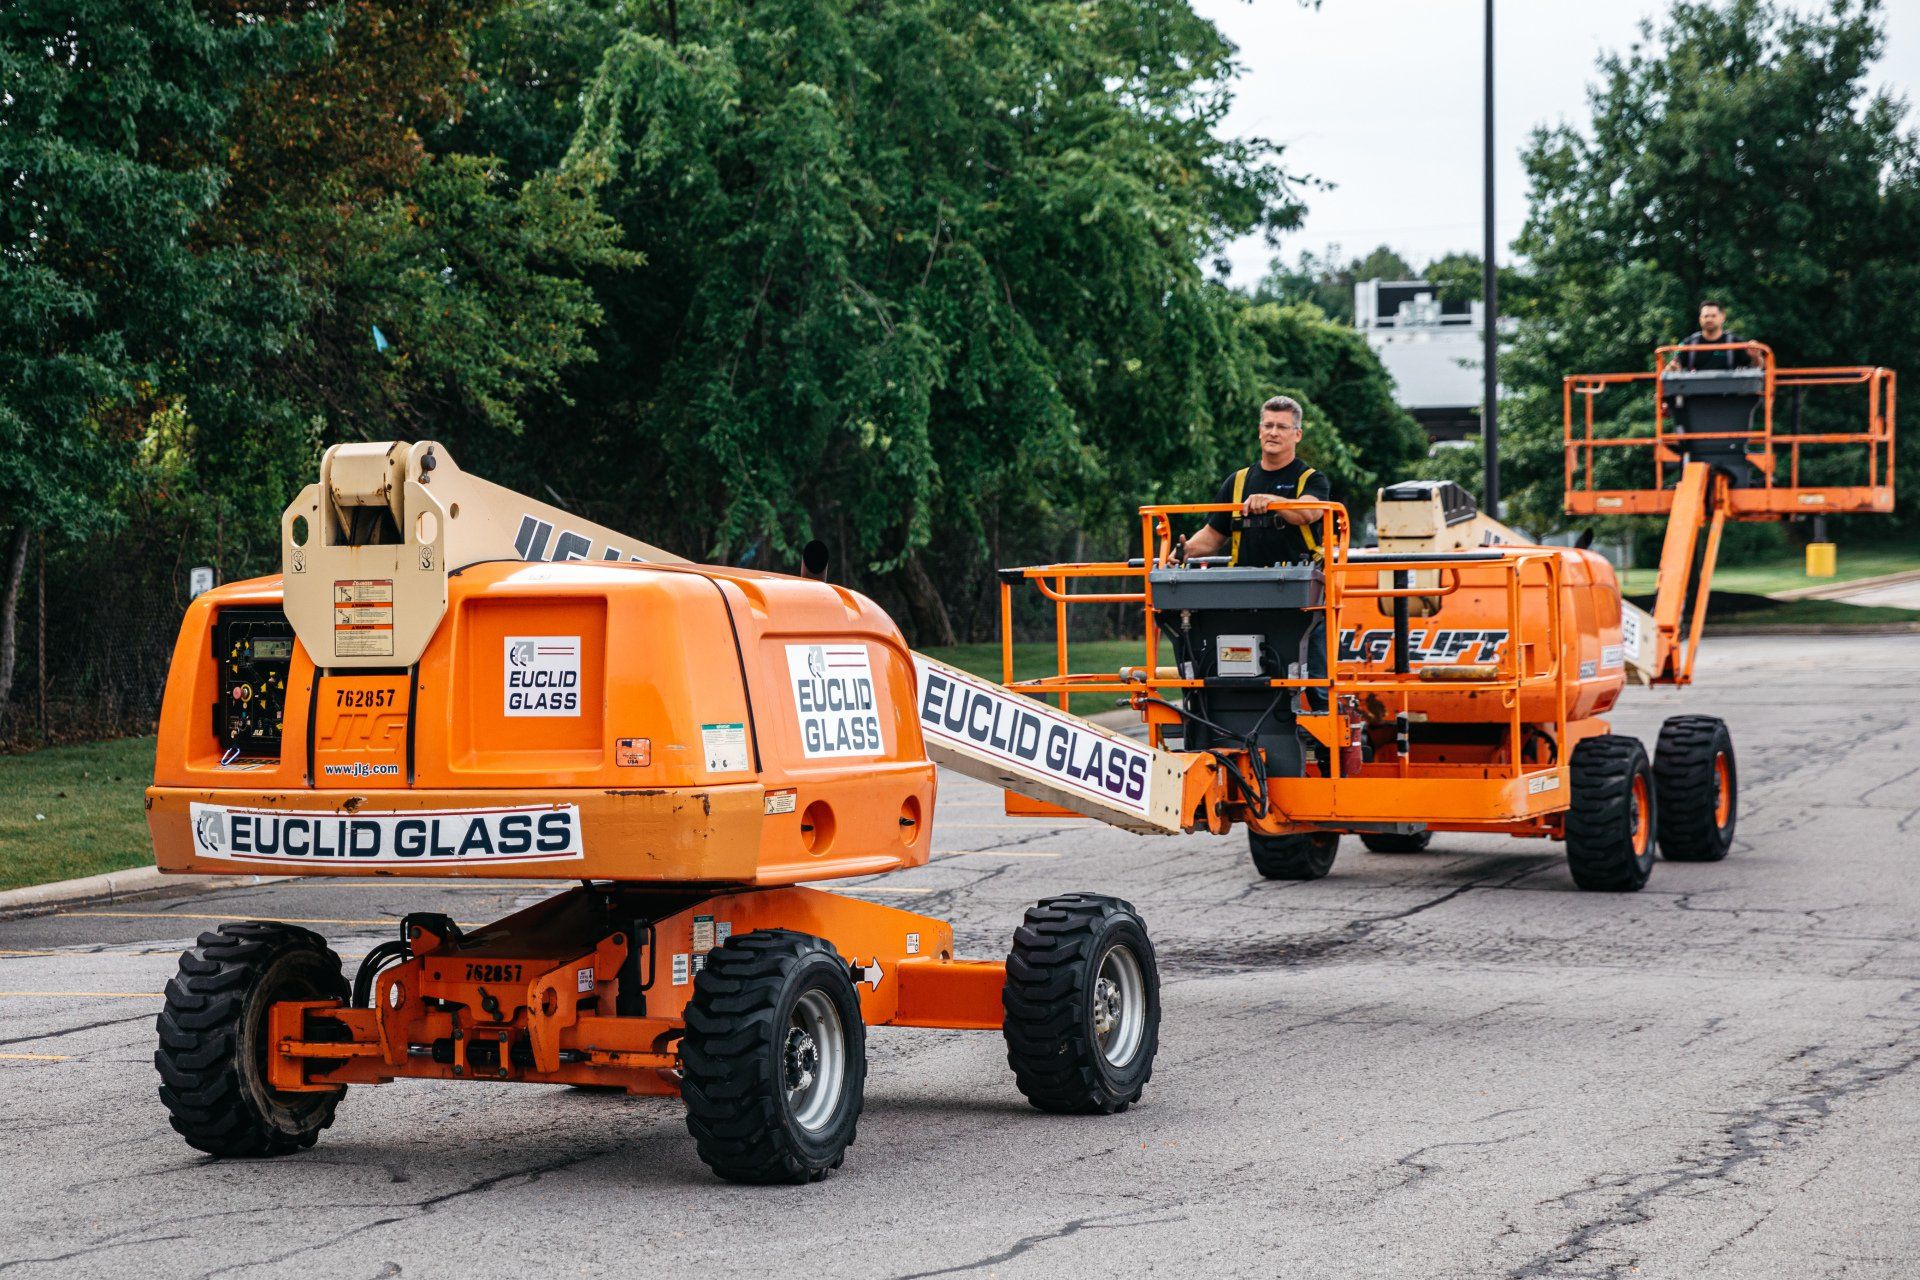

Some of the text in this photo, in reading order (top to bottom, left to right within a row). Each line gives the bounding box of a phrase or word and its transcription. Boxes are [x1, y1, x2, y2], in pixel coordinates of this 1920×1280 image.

[509, 671, 577, 688] EUCLID
[336, 689, 395, 707] 762857
[509, 693, 577, 710] GLASS
[798, 678, 872, 712] EUCLID
[805, 717, 879, 752] GLASS
[921, 673, 1147, 801] EUCLID GLASS
[325, 763, 398, 776] www.jlg.com
[231, 815, 381, 857] EUCLID
[394, 813, 571, 857] GLASS
[465, 963, 523, 983] 762857
